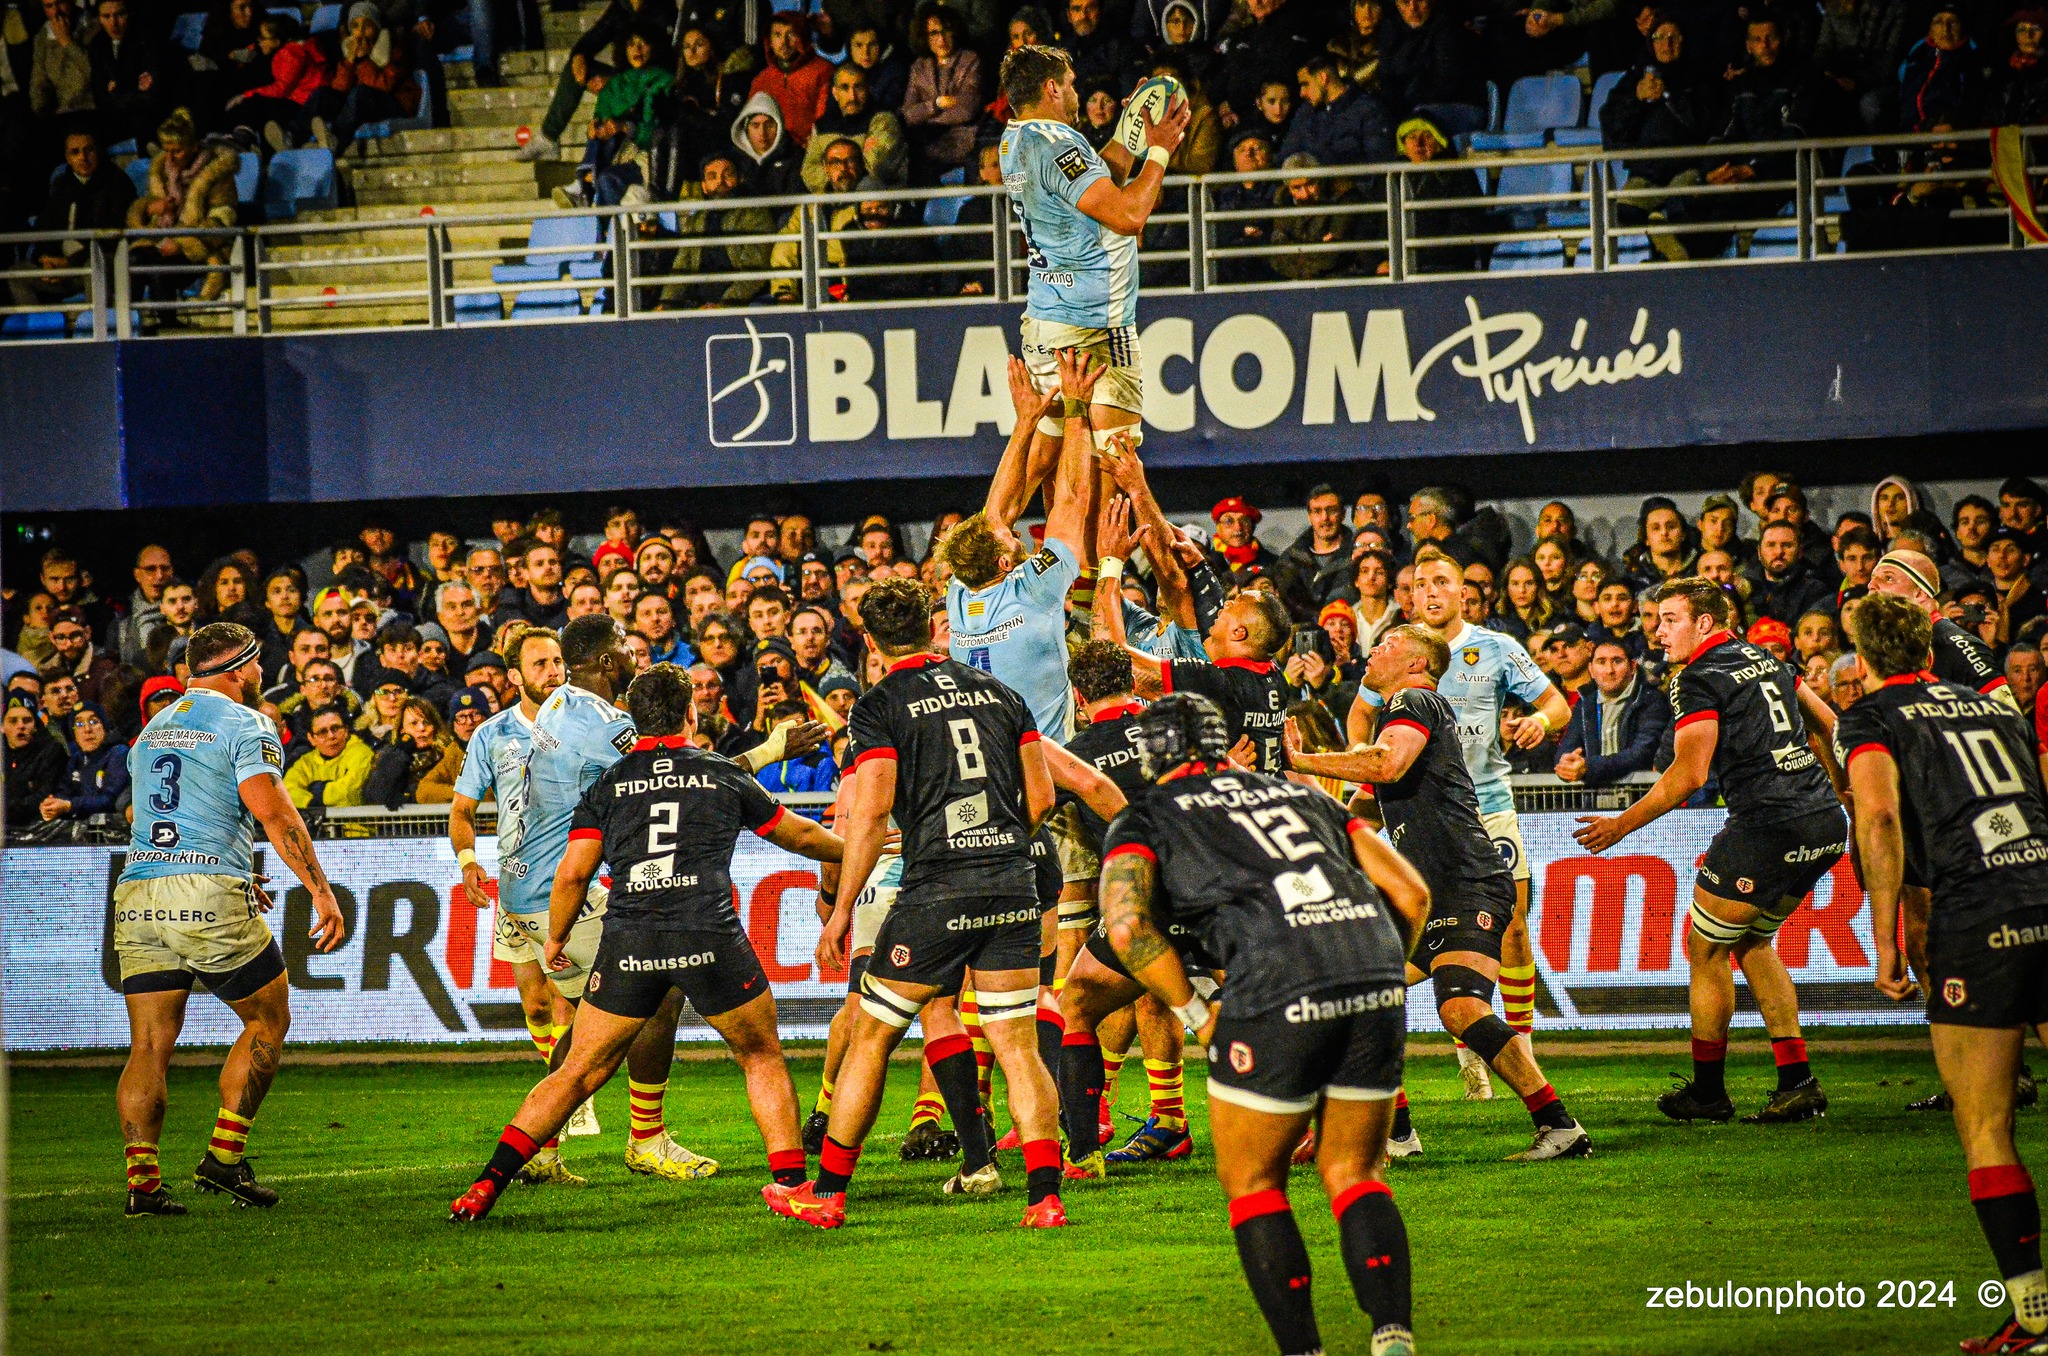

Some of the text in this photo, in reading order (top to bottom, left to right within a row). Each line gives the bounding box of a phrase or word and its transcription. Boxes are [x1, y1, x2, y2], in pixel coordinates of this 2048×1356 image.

[1127, 89, 1161, 151] GILBRT
[1058, 150, 1079, 165] TOP
[1067, 164, 1086, 178] 14
[805, 295, 1681, 444] BLACOM Pyrénées
[1950, 634, 1993, 676] actual
[1460, 671, 1490, 683] Azura
[907, 689, 1002, 718] FIDUCIAL
[1759, 681, 1792, 733] 6
[1899, 700, 2014, 722] FIDUCIAL
[140, 730, 217, 743] GROUPE MAURIN
[149, 740, 197, 749] AUTOMOBILE
[614, 729, 633, 746] TOP
[947, 718, 988, 781] 8
[1943, 729, 2026, 798] 10
[149, 753, 183, 814] 3
[614, 774, 717, 797] FIDUCIAL
[1174, 784, 1309, 811] FIDUCIAL
[648, 801, 680, 853] 2
[1228, 805, 1326, 862] 12
[947, 832, 1015, 850] TOULOUSE
[1981, 846, 2048, 869] TOULOU
[626, 876, 698, 893] TOULOUSE
[946, 907, 1039, 931] chausson
[1284, 903, 1378, 927] TOULOUSE
[1988, 922, 2048, 949] chau
[618, 951, 715, 972] chausson
[1285, 986, 1405, 1024] chausson
